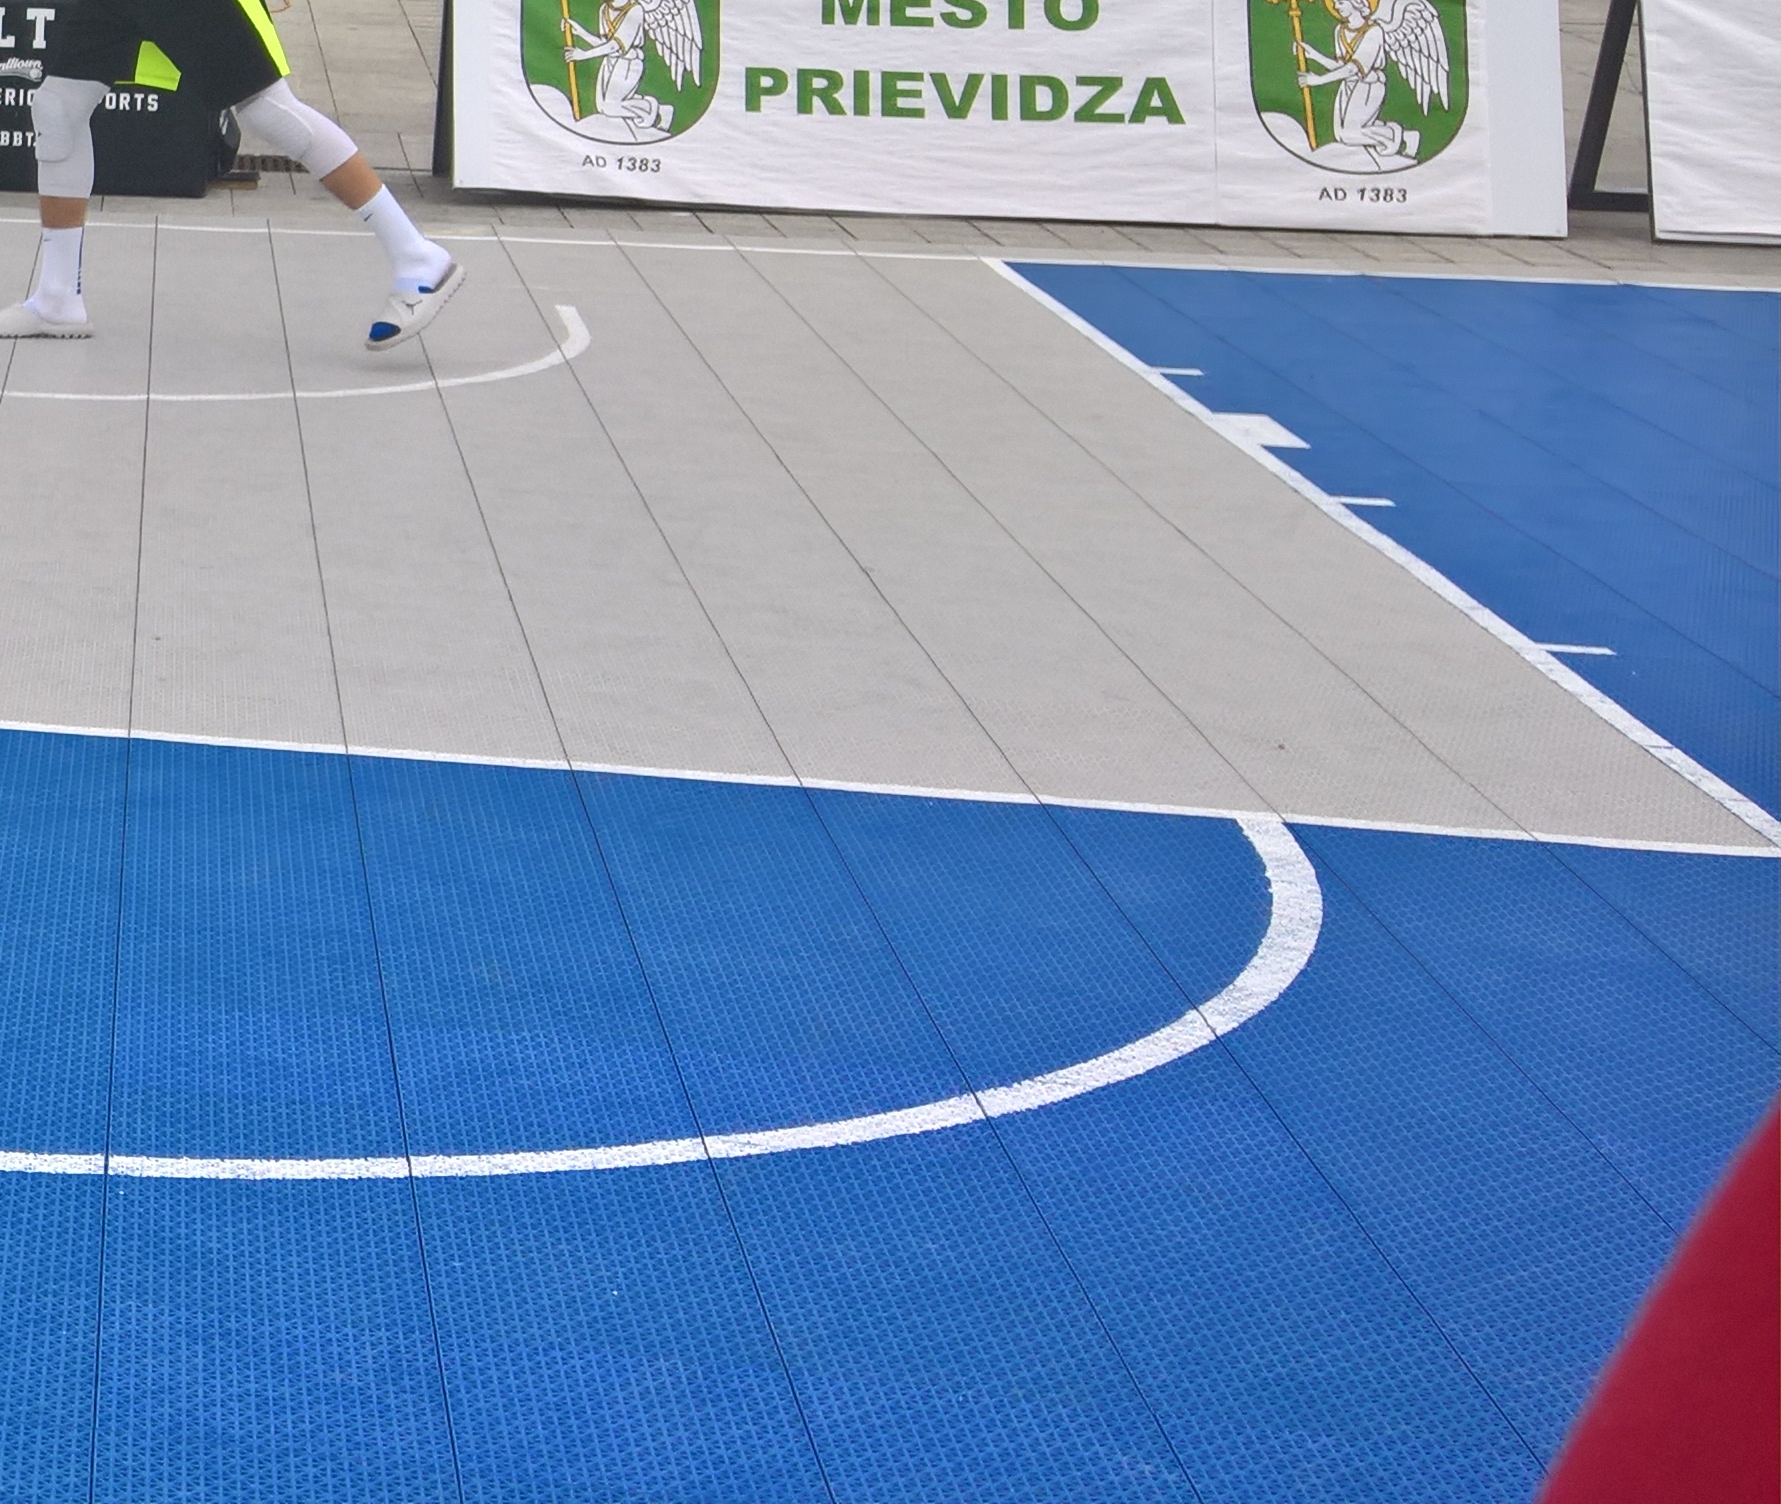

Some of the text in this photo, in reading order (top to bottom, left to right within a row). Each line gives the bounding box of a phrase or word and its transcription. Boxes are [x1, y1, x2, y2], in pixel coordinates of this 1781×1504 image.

[745, 66, 1187, 126] PRIEVIDZA
[582, 154, 662, 174] AD 1383
[1318, 186, 1408, 205] AD 1383
